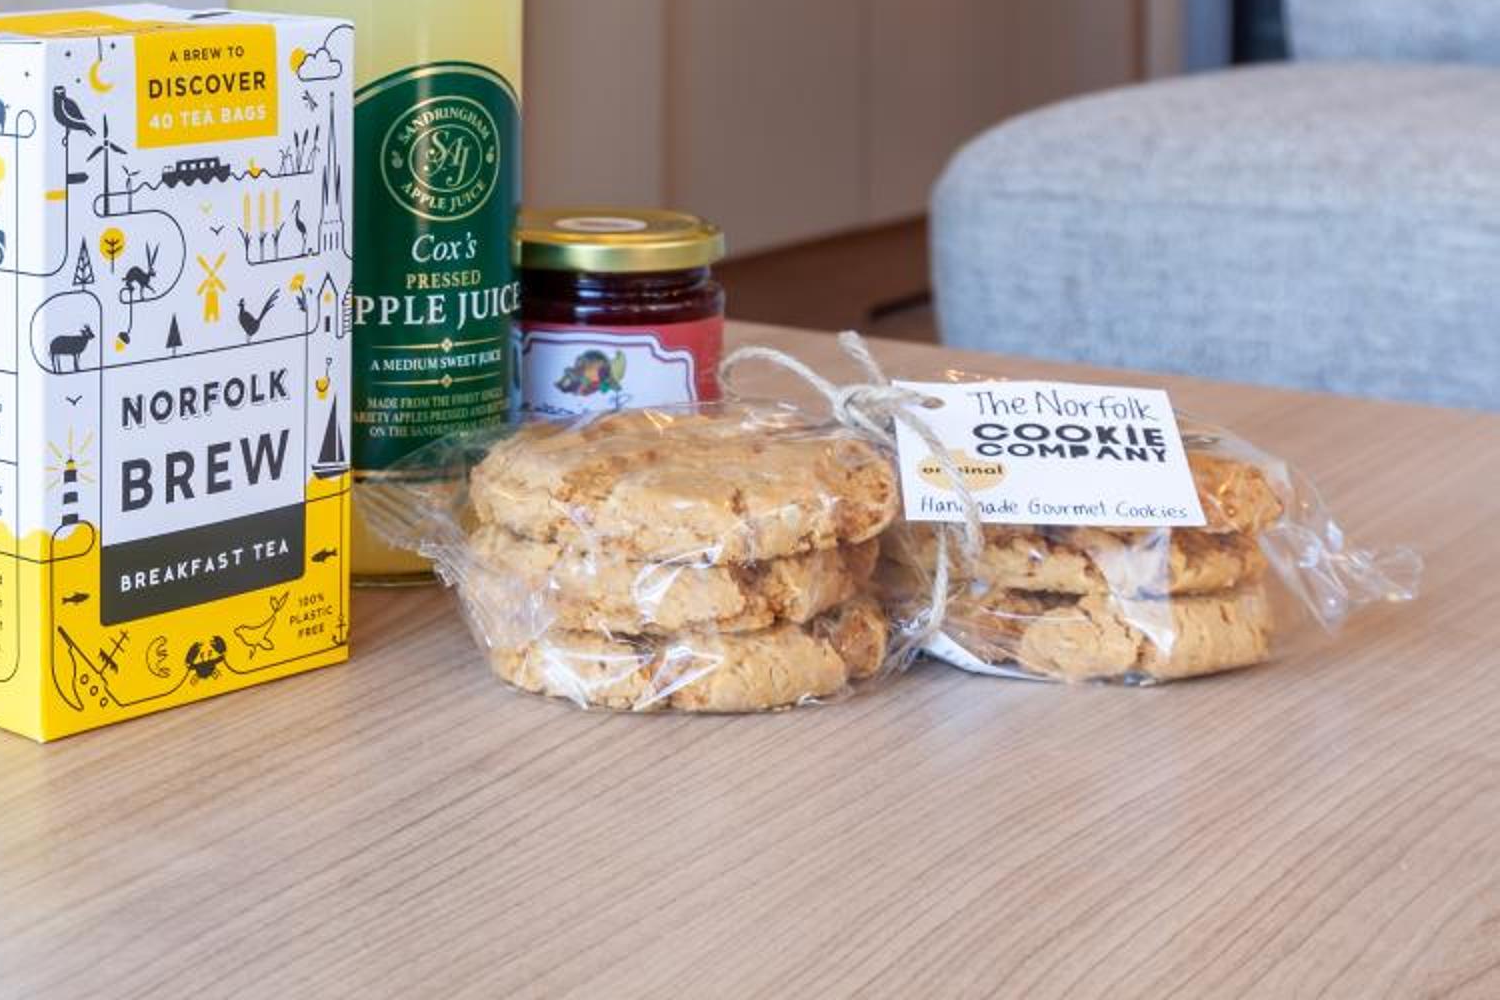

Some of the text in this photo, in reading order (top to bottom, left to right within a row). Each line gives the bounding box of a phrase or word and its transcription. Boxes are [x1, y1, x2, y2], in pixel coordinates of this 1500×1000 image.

[169, 45, 245, 63] A BREW TO
[148, 71, 266, 100] DISCOVER
[149, 104, 266, 130] 40 TEA BAGS
[402, 106, 491, 145] SANDRINGHAM
[401, 181, 447, 210] APPLE
[411, 232, 478, 263] Cox's
[405, 269, 482, 290] PRESSED
[353, 281, 522, 331] PPLE JUICE
[383, 357, 439, 372] MEDIUM
[440, 354, 477, 369] SWEET
[121, 367, 290, 430] NORFOLK
[967, 389, 1159, 422] The Norfolk
[972, 422, 1167, 448] COOKIE
[975, 442, 1169, 464] COMPANY
[122, 429, 290, 513] BREW
[922, 463, 1004, 476] orinal
[920, 494, 1189, 520] Hanade Gourmet Cookies
[120, 538, 290, 593] BREAKFAST TEA
[289, 604, 334, 627] PLASTIC
